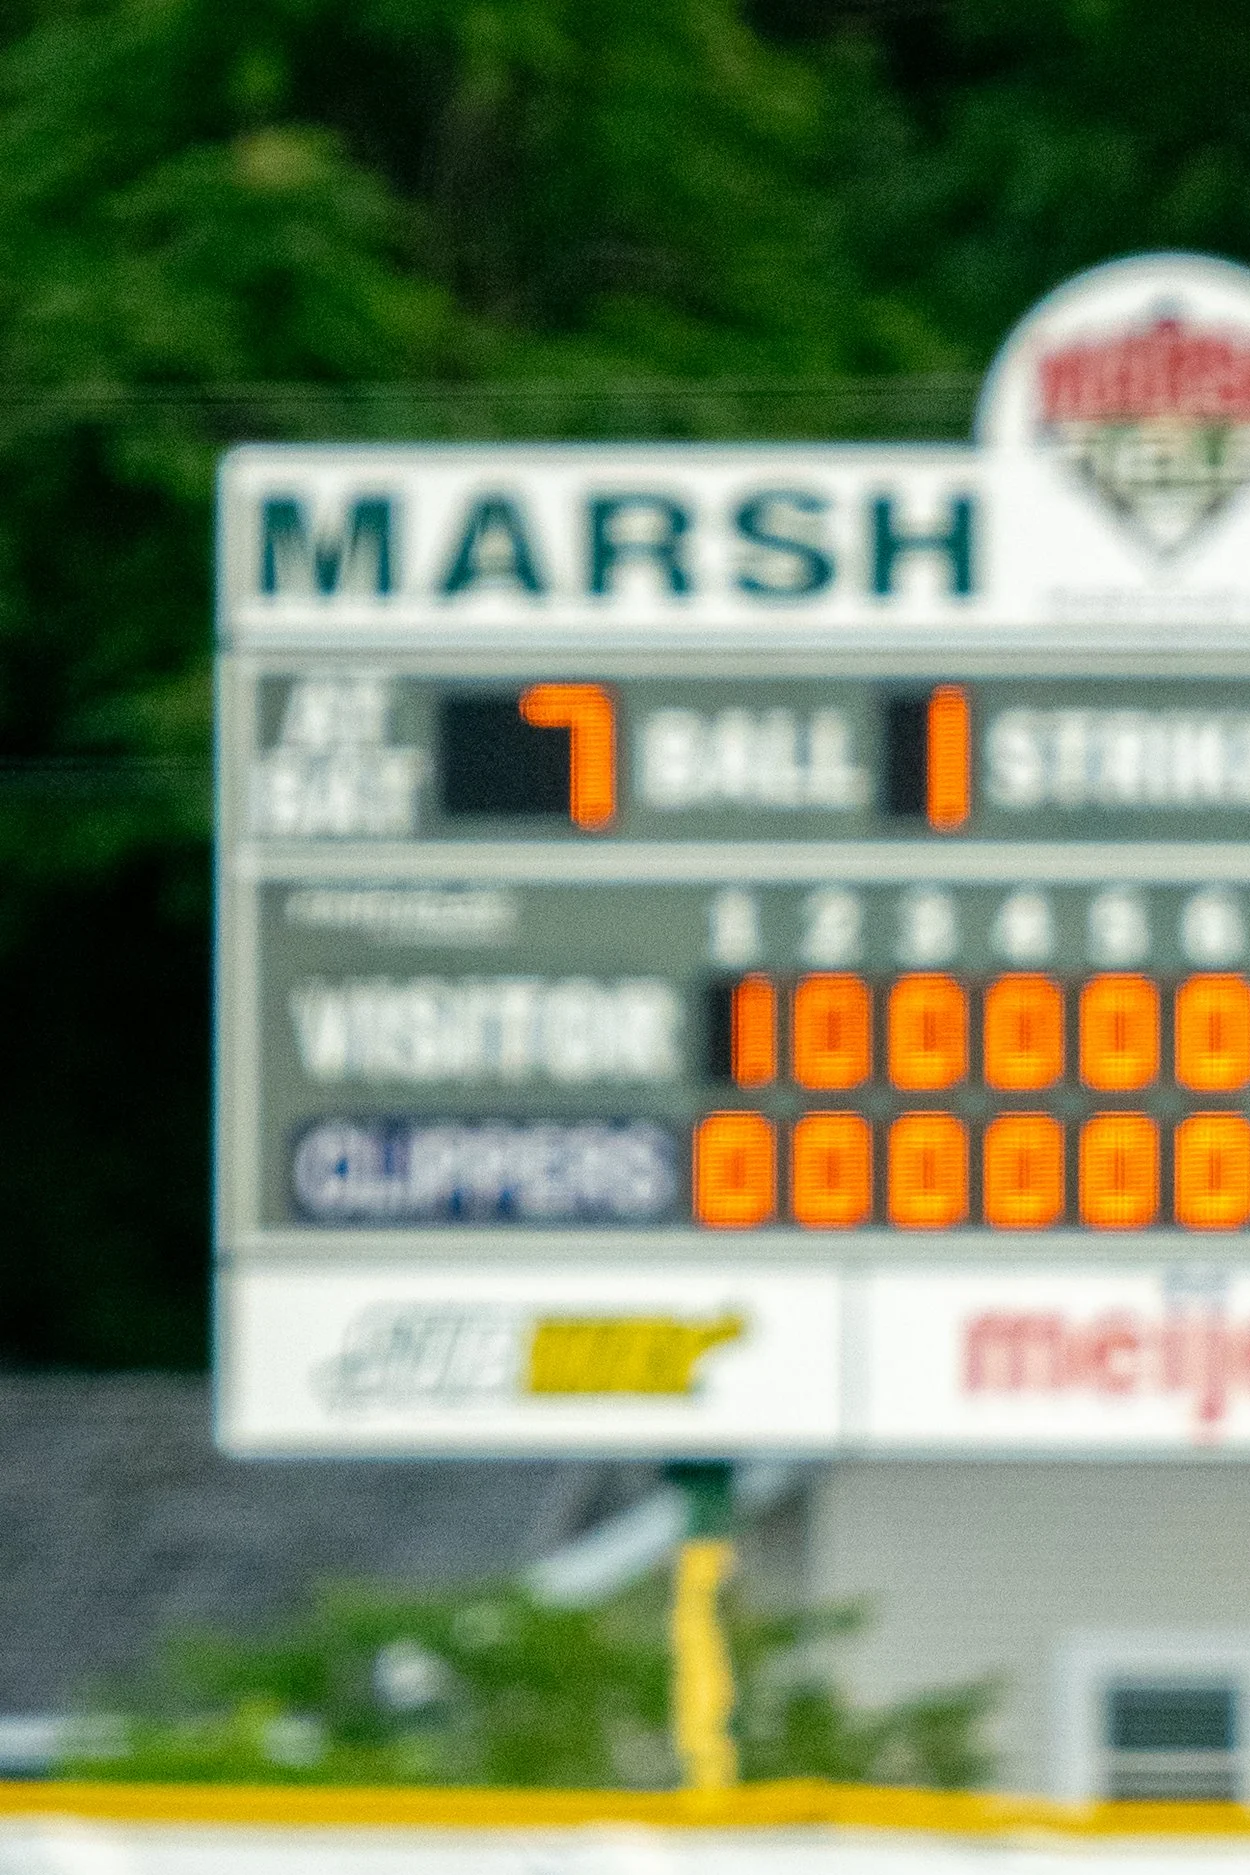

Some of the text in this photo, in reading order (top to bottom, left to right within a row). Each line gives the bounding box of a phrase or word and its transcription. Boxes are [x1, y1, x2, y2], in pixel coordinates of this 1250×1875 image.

[258, 488, 976, 598] MARSH
[252, 752, 425, 838] BAT
[519, 683, 617, 830] 7
[640, 705, 865, 808] BALL
[926, 685, 972, 830] 1
[290, 975, 685, 1080] VISITOR
[290, 1113, 682, 1222] CLIPPERS
